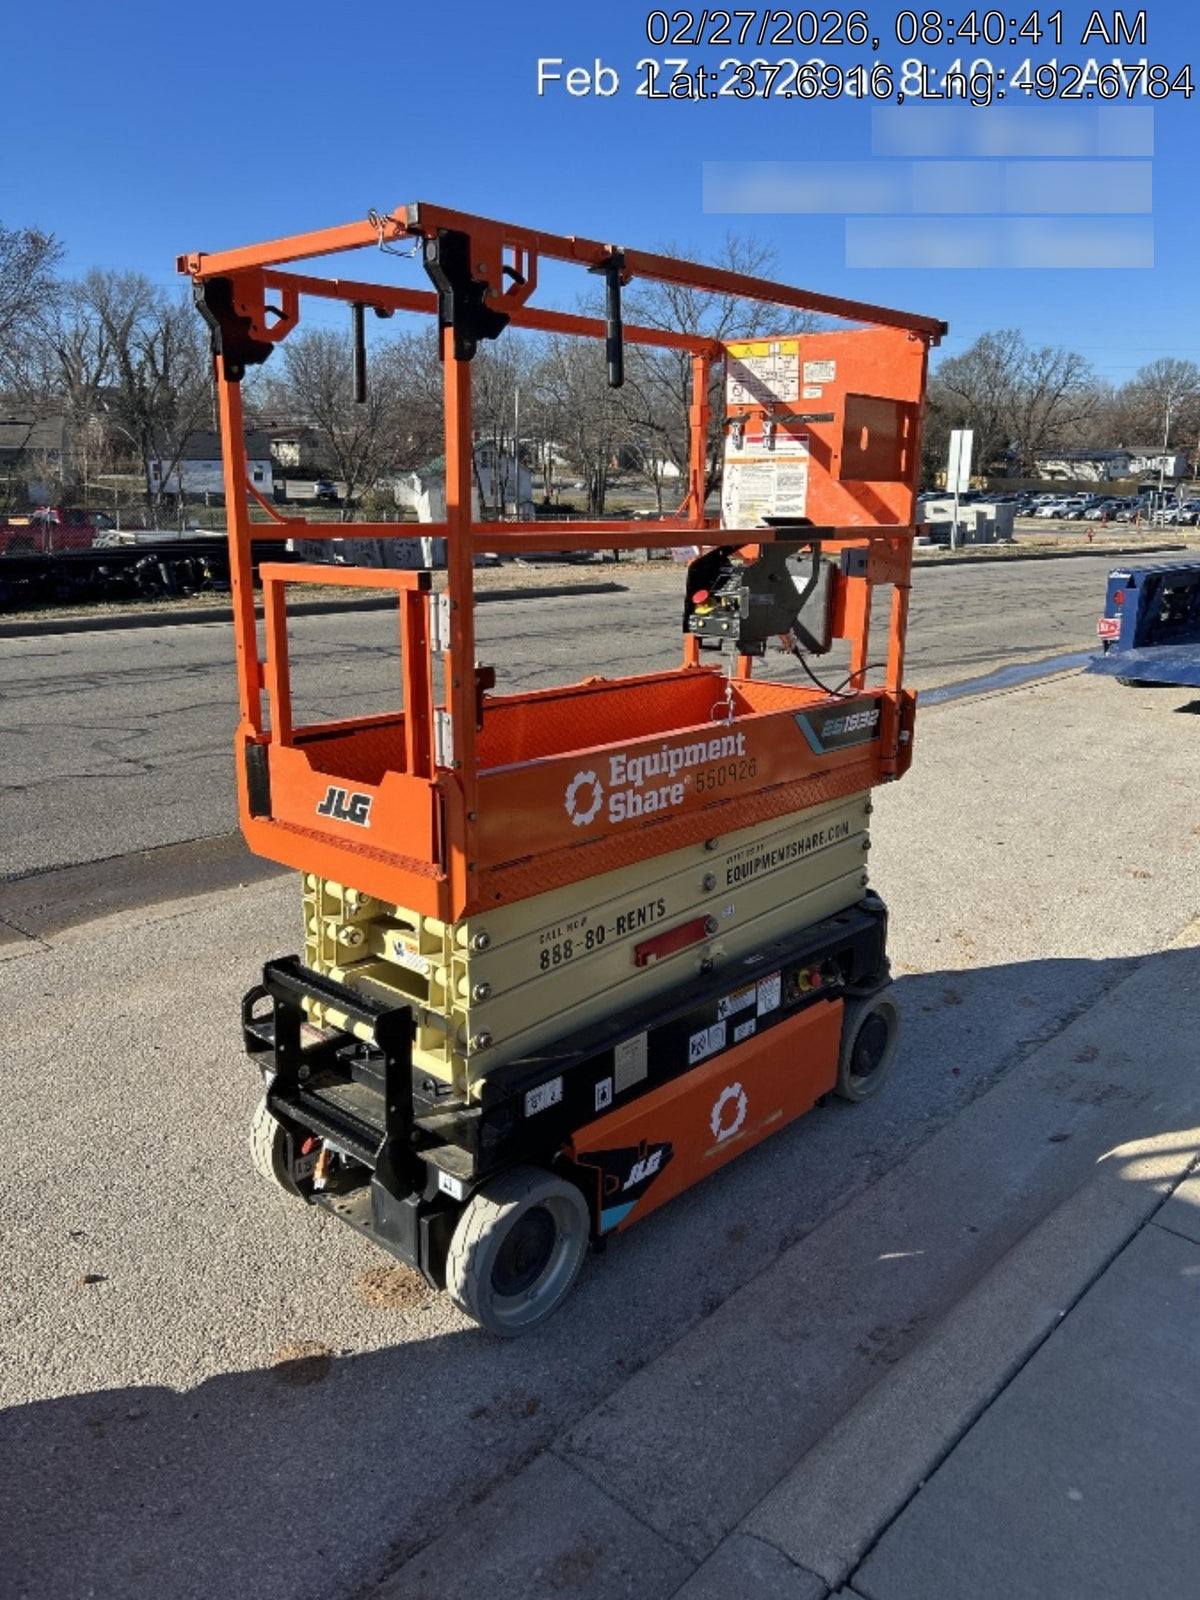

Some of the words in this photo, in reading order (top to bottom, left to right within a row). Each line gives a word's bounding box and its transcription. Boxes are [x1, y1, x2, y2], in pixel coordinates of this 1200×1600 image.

[609, 732, 746, 787] Equipment
[316, 785, 374, 828] JLG
[726, 820, 849, 886] EQUIPMENTSHARE.COM
[622, 1150, 663, 1192] JLG
